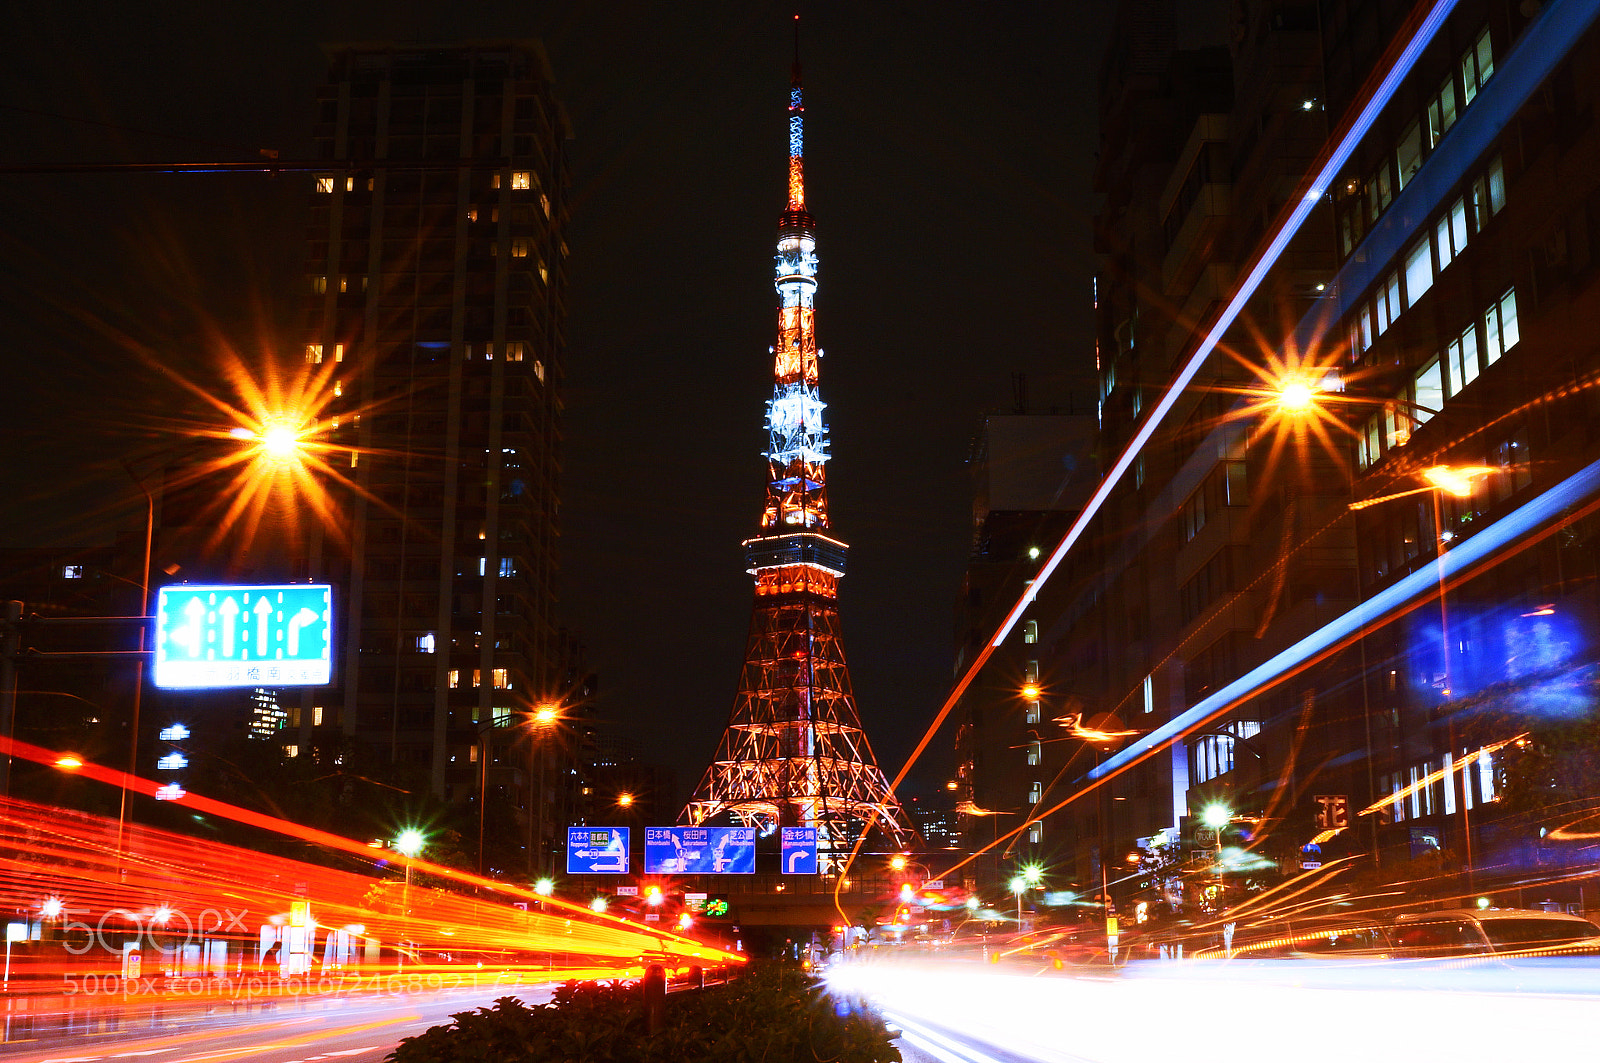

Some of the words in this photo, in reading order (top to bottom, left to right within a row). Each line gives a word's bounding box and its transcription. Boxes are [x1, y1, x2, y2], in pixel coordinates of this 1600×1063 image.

[570, 831, 589, 841] 六本木
[647, 830, 671, 840] 日本橋
[683, 830, 708, 840] 桜田門
[785, 829, 815, 840] 金杉橋
